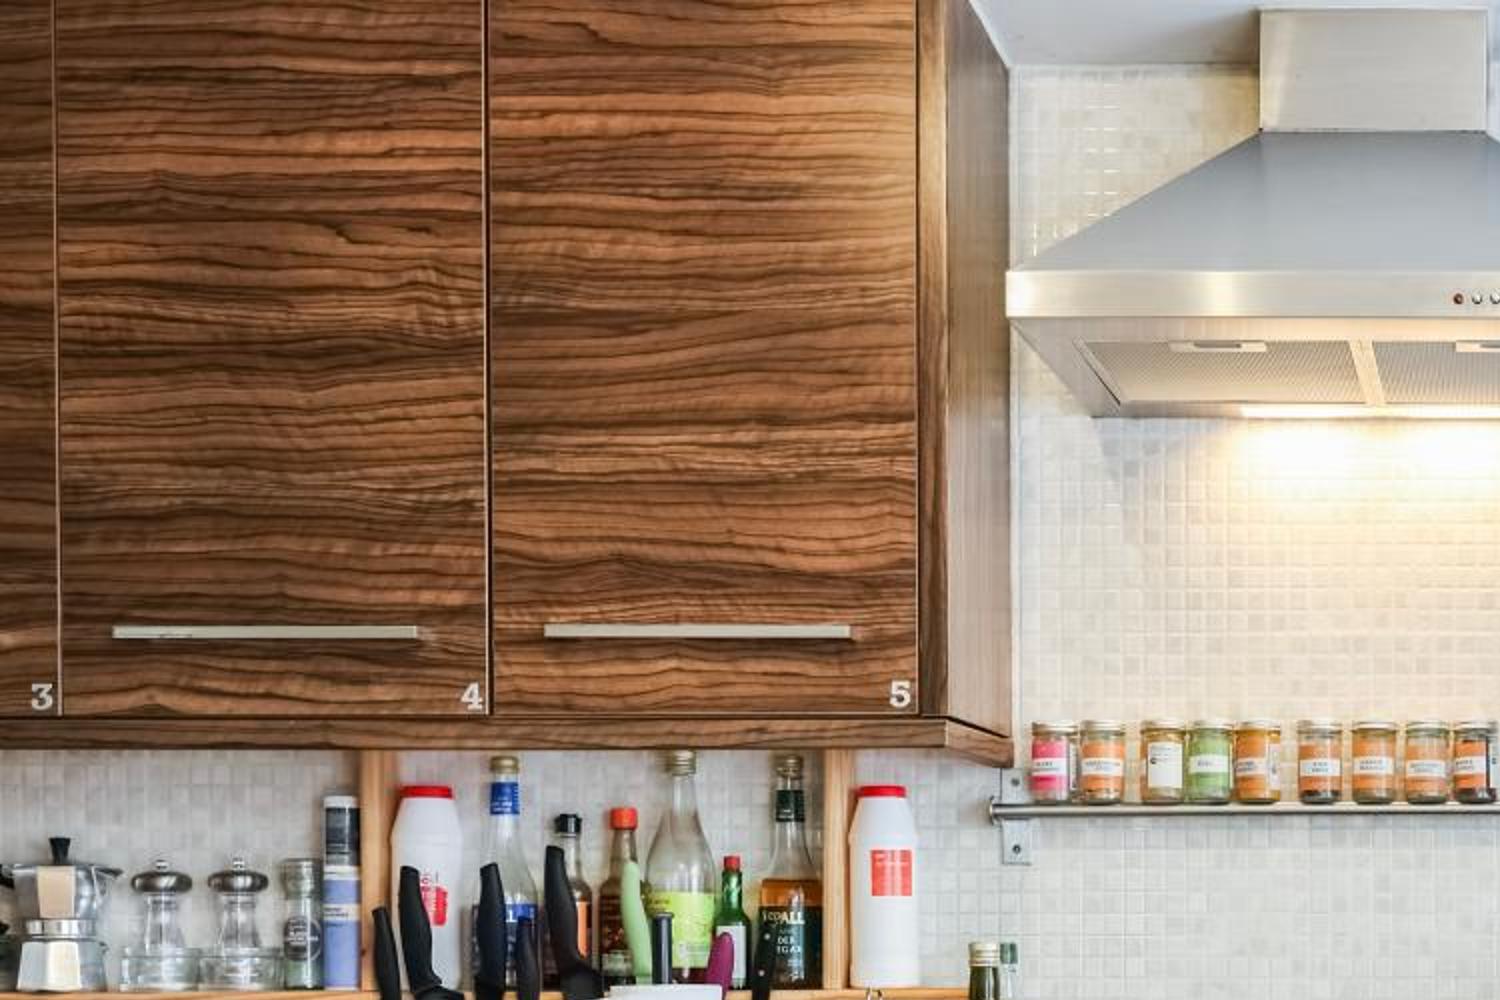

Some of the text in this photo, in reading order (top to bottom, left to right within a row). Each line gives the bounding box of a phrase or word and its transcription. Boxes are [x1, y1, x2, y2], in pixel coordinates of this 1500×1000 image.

[31, 683, 53, 710] 3
[460, 681, 483, 710] 4
[889, 680, 911, 708] 5
